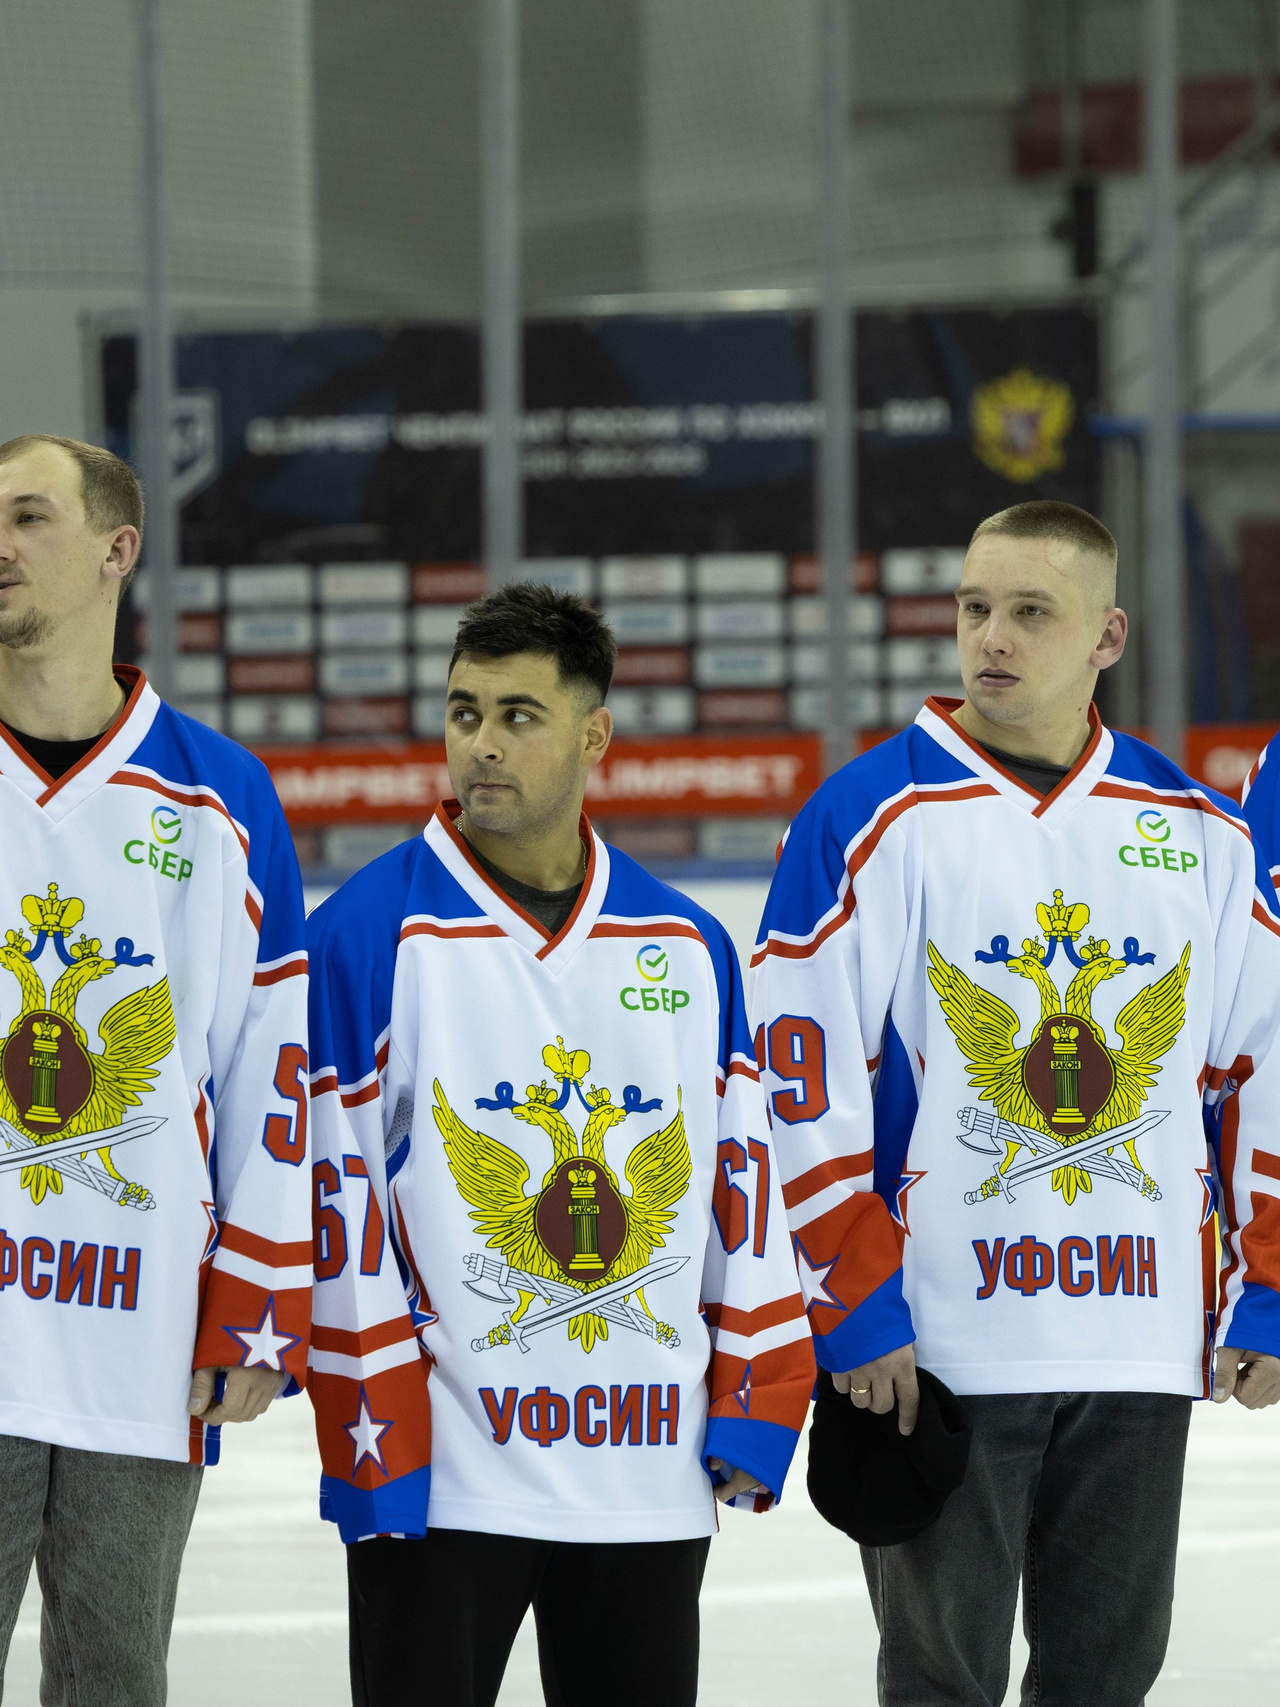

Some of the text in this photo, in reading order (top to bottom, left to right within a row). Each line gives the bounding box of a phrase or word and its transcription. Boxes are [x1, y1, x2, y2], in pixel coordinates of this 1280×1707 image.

[124, 840, 193, 882] СБЕР
[1118, 845, 1198, 873] СБЕР
[619, 986, 690, 1014] СБЕР
[31, 1056, 59, 1069] ЗАКОН
[1052, 1060, 1080, 1070] ЗАКОН
[570, 1205, 598, 1215] ЗАКОН
[711, 1136, 771, 1259] 67
[312, 1154, 385, 1283] 67
[971, 1235, 1159, 1301] УФСИН
[478, 1384, 680, 1449] УФСИН
